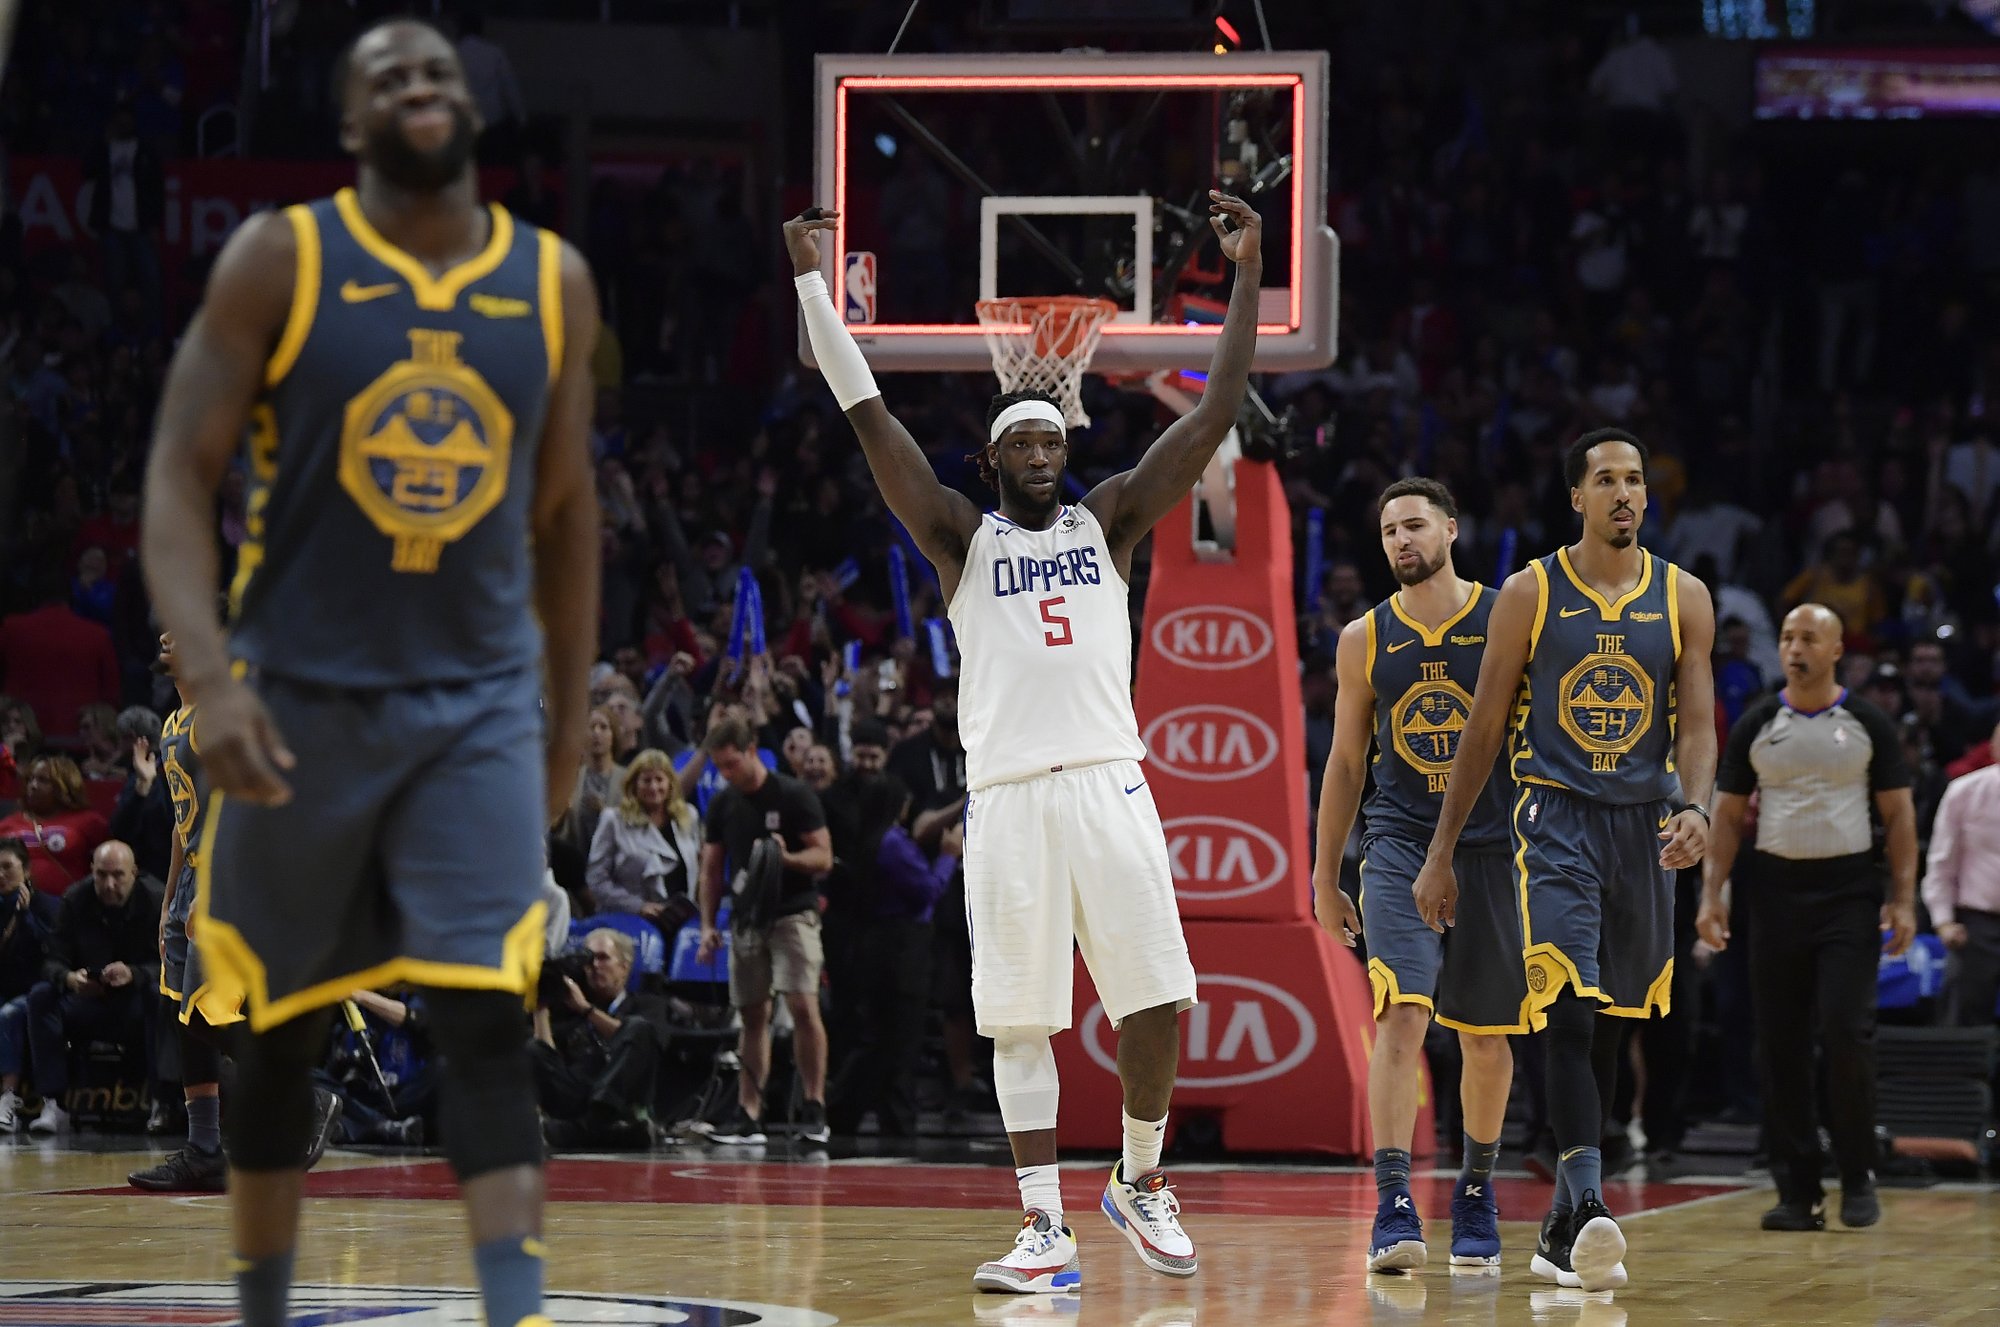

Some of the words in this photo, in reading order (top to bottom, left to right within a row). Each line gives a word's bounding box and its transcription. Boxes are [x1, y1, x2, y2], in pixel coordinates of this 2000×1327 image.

[992, 546, 1101, 597] CLIPPERS
[1039, 595, 1073, 647] 5
[1630, 611, 1663, 622] Rakuten
[1172, 619, 1253, 656] KIA
[1450, 635, 1485, 645] Rakuten
[1596, 634, 1625, 653] THE
[1420, 661, 1448, 681] THE
[1589, 711, 1626, 736] 34
[1165, 721, 1254, 766] KIA
[1429, 734, 1450, 757] 11
[1592, 753, 1620, 772] BAY
[1188, 1001, 1276, 1063] IA
